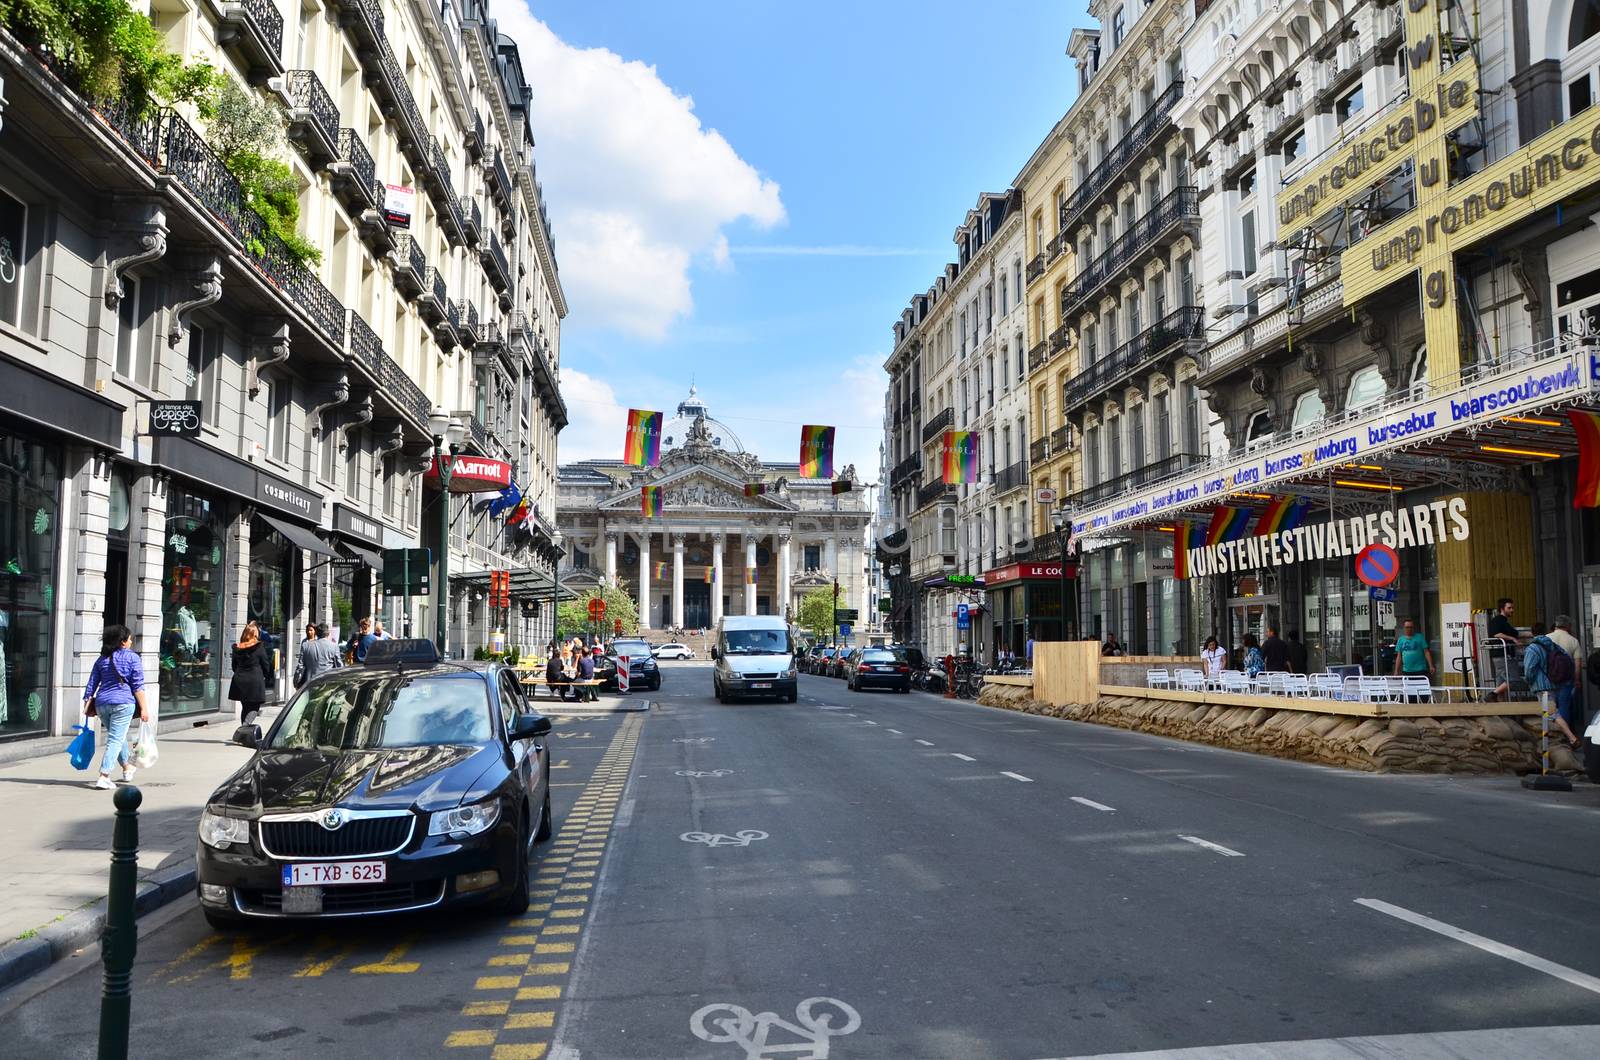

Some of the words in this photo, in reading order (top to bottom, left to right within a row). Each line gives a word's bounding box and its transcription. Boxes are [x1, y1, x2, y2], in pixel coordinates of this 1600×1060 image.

[1279, 80, 1466, 225] unpredictable
[453, 459, 501, 478] Marriott
[264, 484, 311, 513] cosmeticary
[1187, 497, 1470, 578] KUNSTENFESTIVALDESARTS
[1031, 567, 1043, 575] LE
[948, 575, 975, 583] PRESSE
[959, 606, 967, 618] P
[1452, 631, 1460, 639] WE
[384, 641, 417, 652] TAXI
